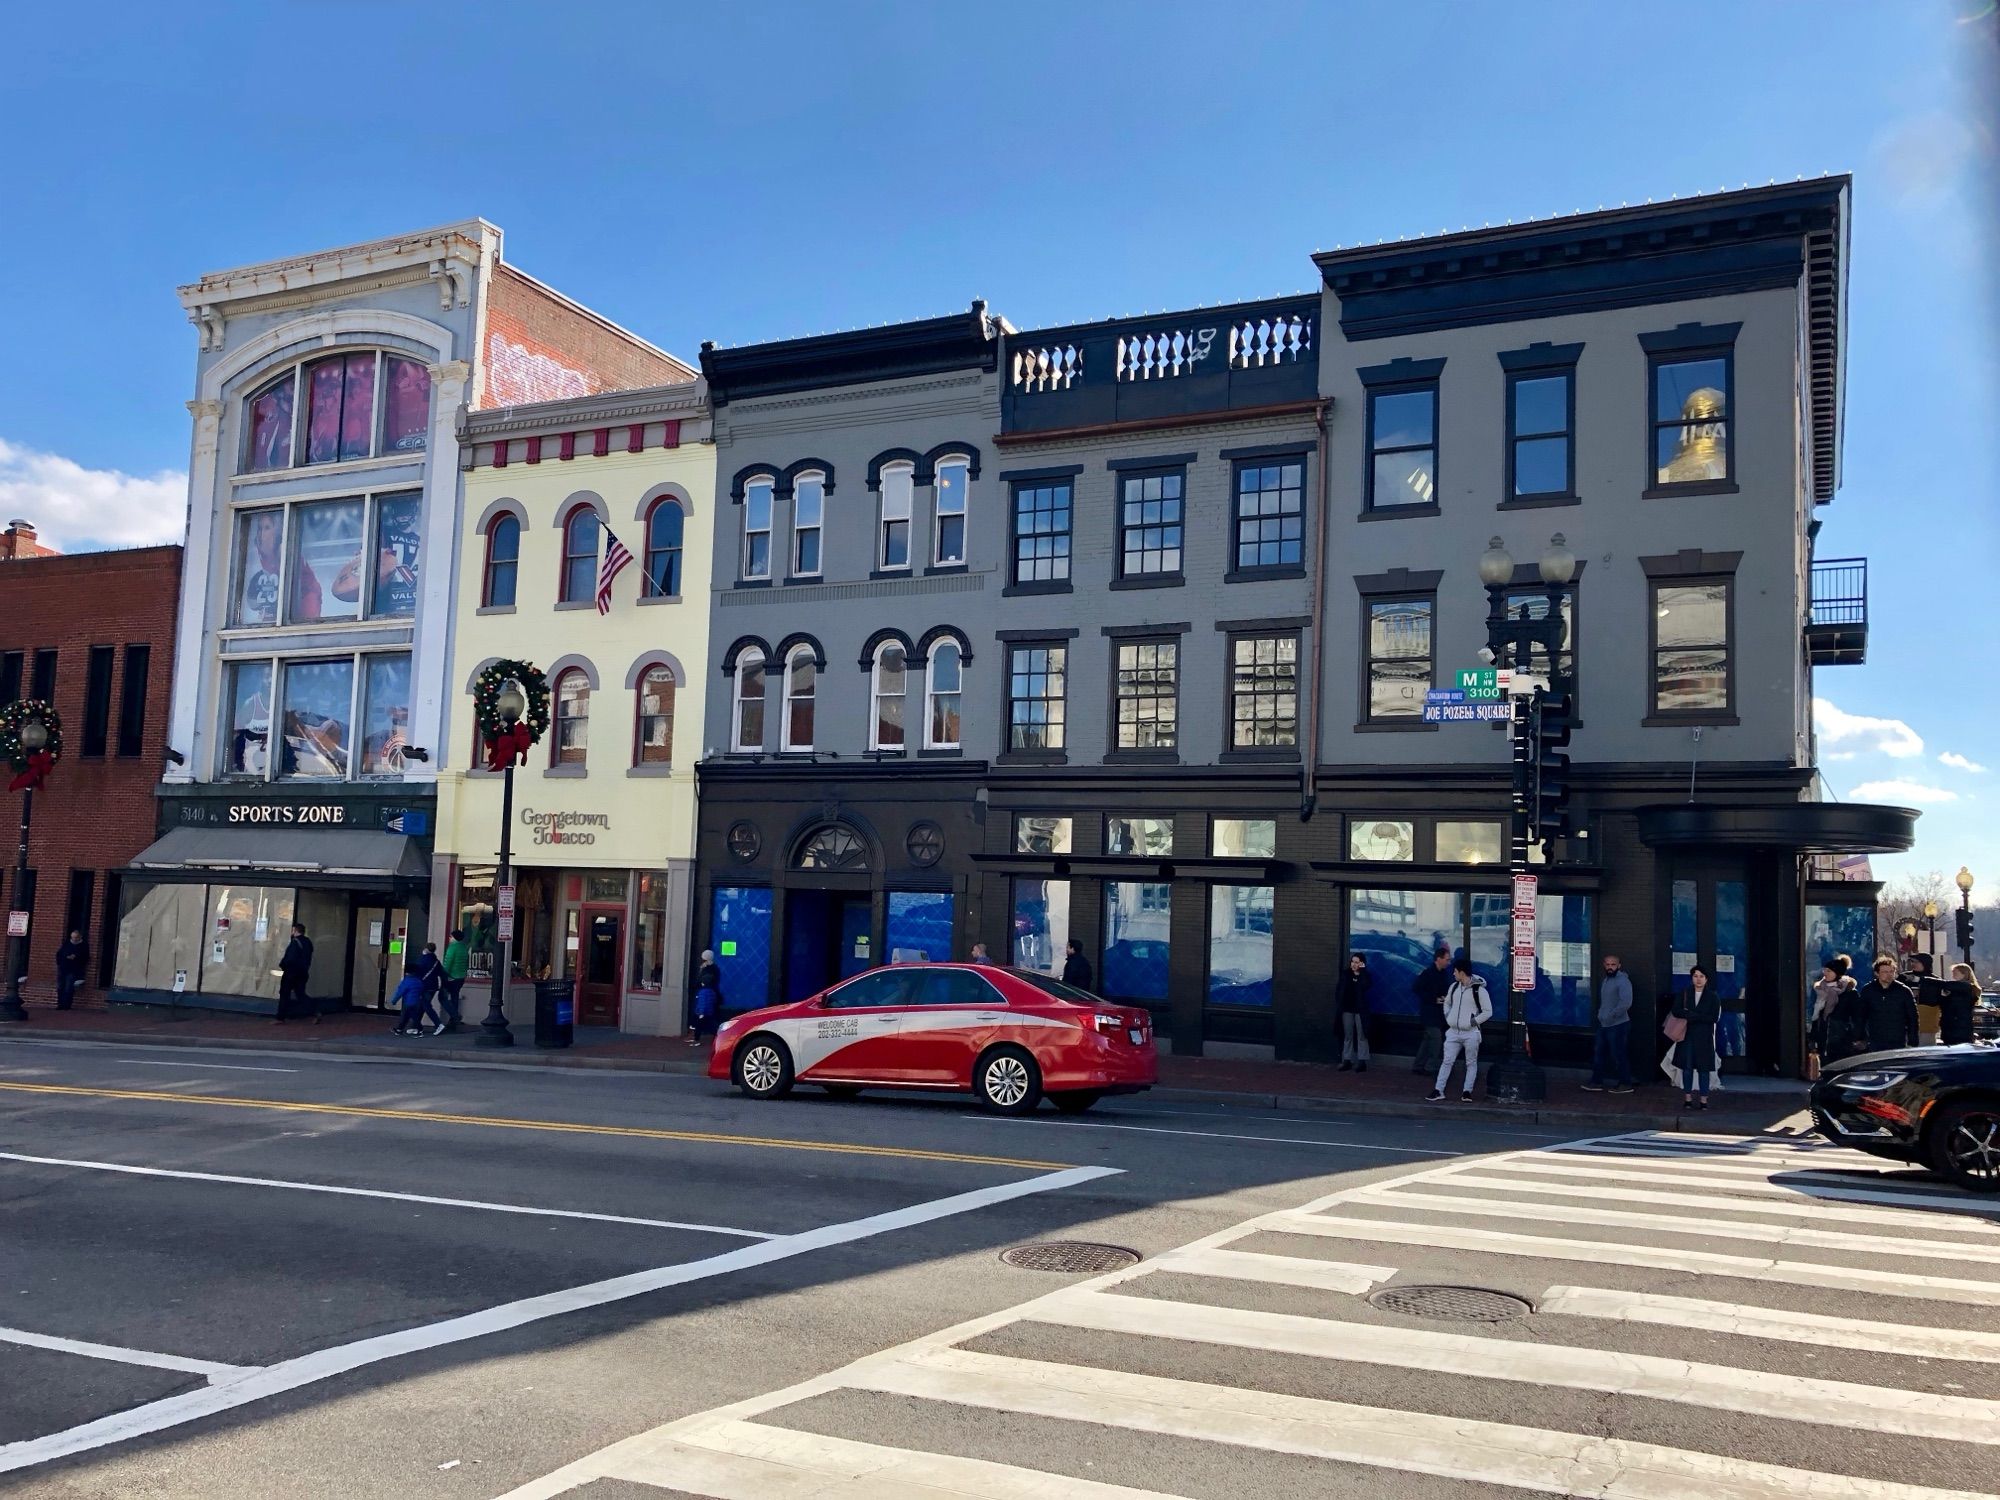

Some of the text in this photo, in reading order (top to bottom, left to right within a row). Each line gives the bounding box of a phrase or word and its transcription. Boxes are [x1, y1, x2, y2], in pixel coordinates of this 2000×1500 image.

[1463, 672, 1478, 687] M
[1469, 687, 1500, 698] 3100
[1425, 704, 1511, 721] JOE POZELL SQUARE
[180, 806, 205, 822] 3140
[228, 805, 344, 823] SPORTS ZONE
[520, 807, 611, 830] Georgetown
[533, 826, 596, 845] Tobacco
[818, 1019, 858, 1029] WELCOME CAB
[818, 1028, 857, 1038] 202-332-4444
